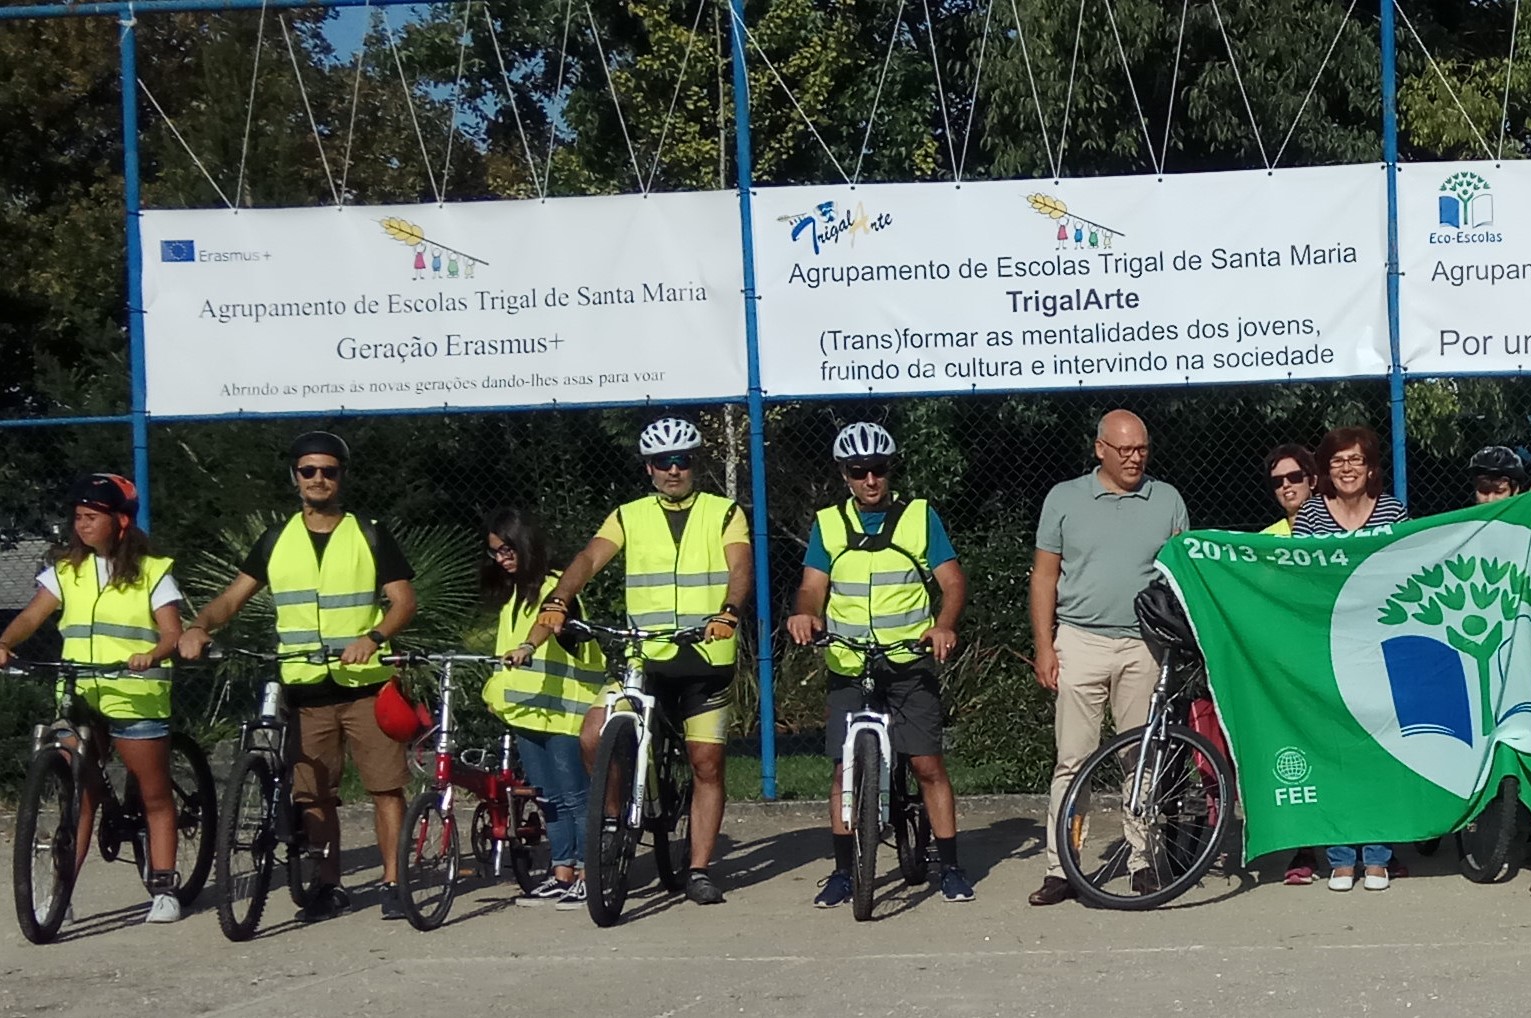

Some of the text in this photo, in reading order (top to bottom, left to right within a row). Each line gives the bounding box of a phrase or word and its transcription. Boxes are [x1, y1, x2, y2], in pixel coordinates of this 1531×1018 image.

[1430, 232, 1502, 244] Eco-Escolas
[789, 243, 1356, 288] Agrupamento de Escolas Trigal de Santa Maria
[200, 282, 706, 323] Agrupamento de Escolas Trigal de Santa Maria
[1006, 289, 1139, 317] TrigalArte
[337, 334, 564, 363] Geração Erasmus+
[820, 317, 1320, 355] (Trans)formar as mentalidades dos jovens,
[1440, 330, 1493, 356] Por
[821, 344, 1333, 380] fruindo da cultura e intervindo na sociedade
[222, 383, 278, 396] Abrindo
[282, 384, 298, 395] as
[303, 384, 345, 397] portas
[369, 382, 411, 393] novas
[416, 377, 477, 394] gerações
[482, 374, 558, 388] dando-lhes
[564, 376, 593, 385] asas
[600, 374, 628, 387] para
[633, 371, 666, 382] voar
[1184, 537, 1257, 562] 2013
[1275, 786, 1317, 806] FEE
